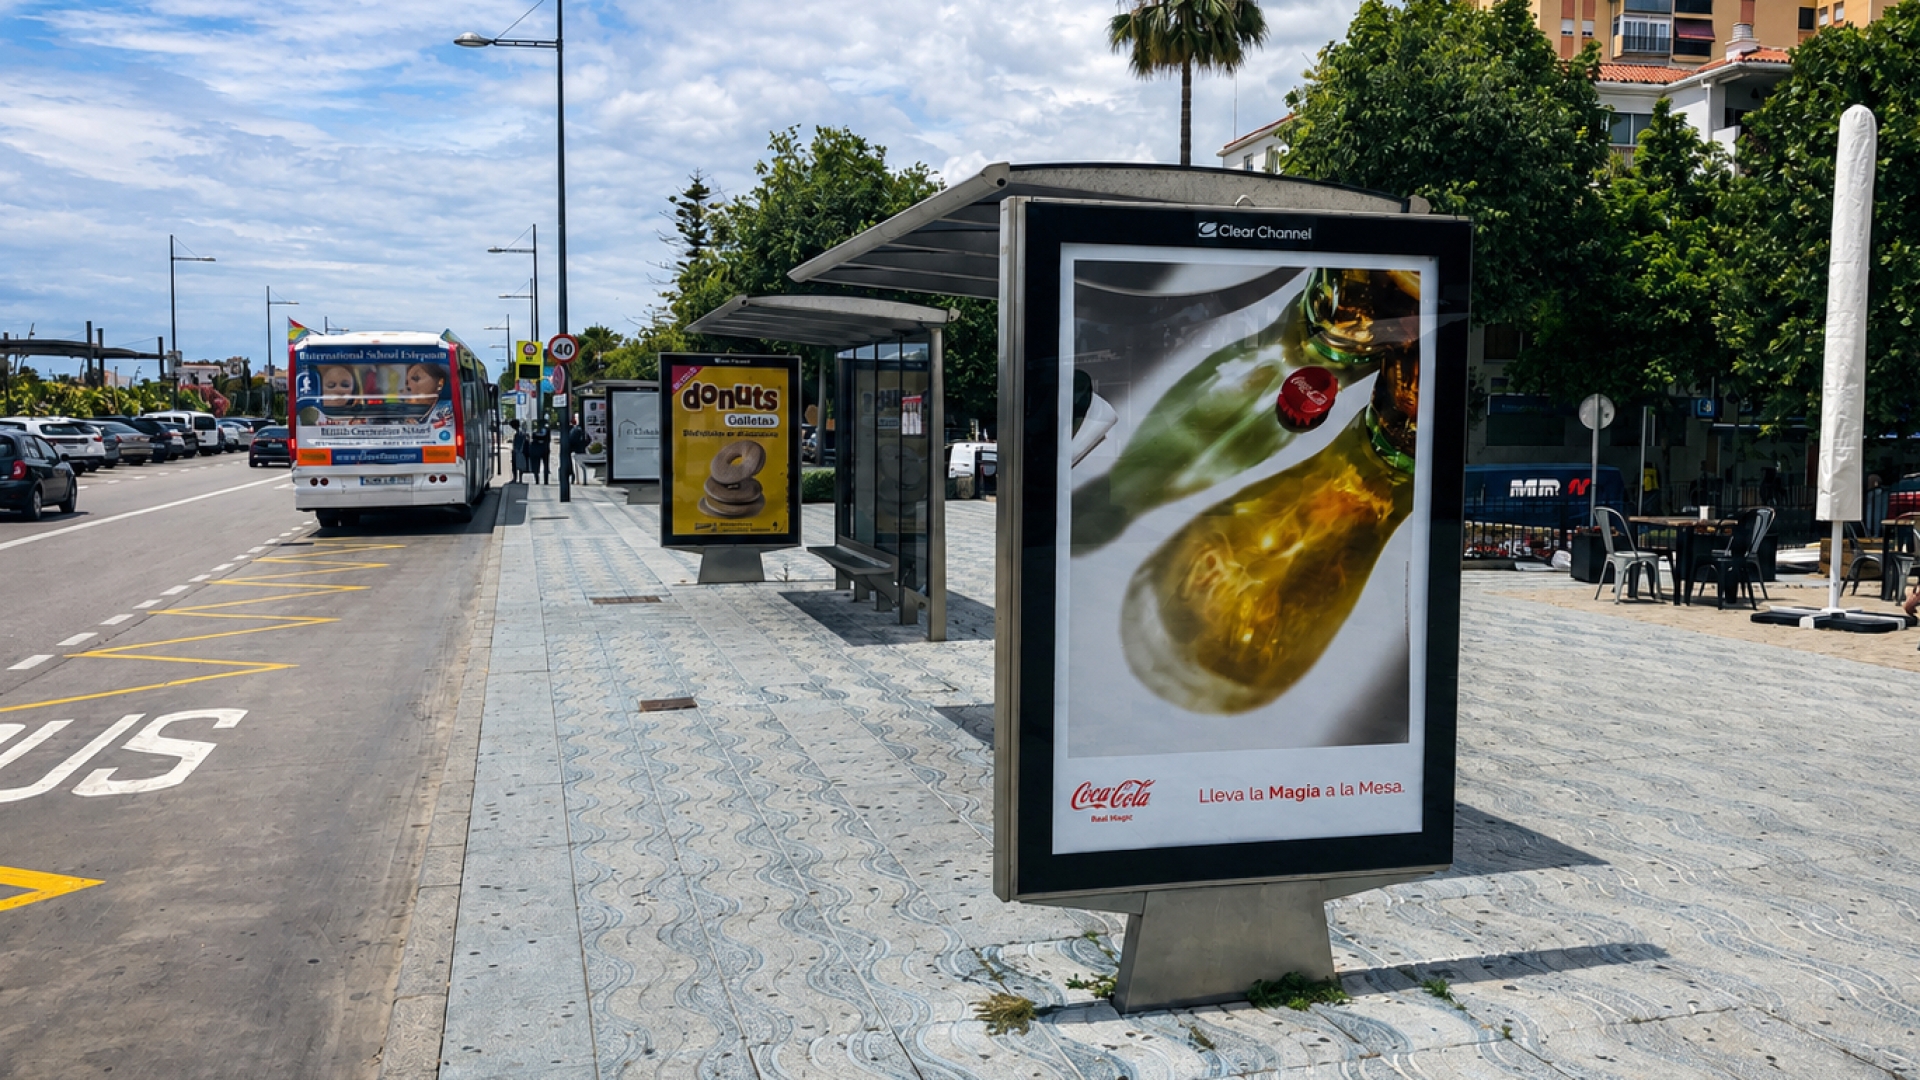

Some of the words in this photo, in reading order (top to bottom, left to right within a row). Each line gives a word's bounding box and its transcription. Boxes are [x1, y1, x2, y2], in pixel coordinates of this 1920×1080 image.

[1219, 224, 1255, 238] Clear
[1257, 225, 1312, 240] Channel
[554, 343, 573, 356] 40
[682, 380, 779, 412] donuts
[0, 707, 249, 802] US
[1199, 788, 1244, 803] Lleva
[1249, 786, 1264, 801] la
[1269, 783, 1321, 802] Magia
[1325, 785, 1335, 797] a
[1340, 782, 1354, 796] la
[1359, 780, 1406, 795] Mesa.
